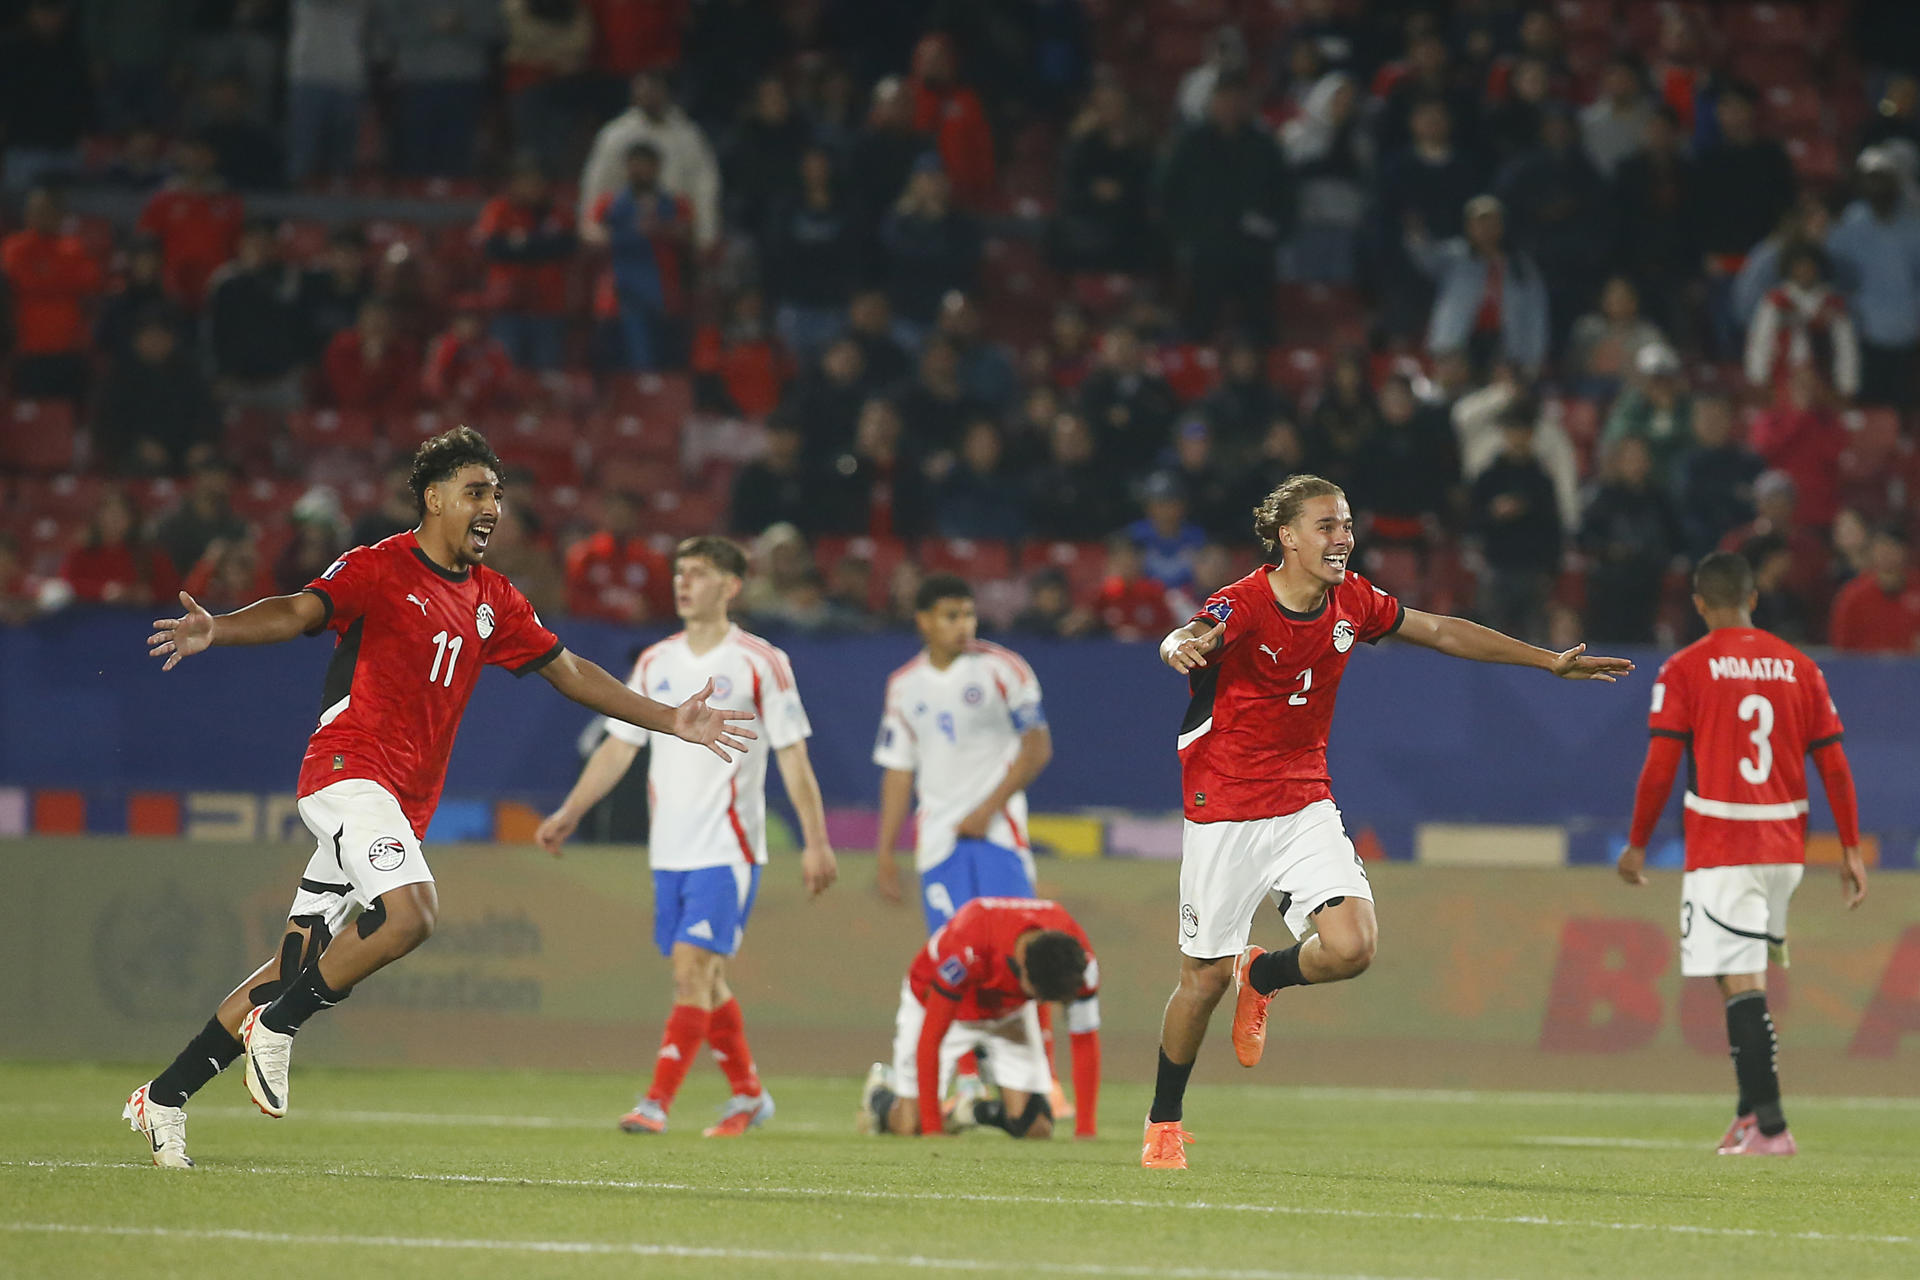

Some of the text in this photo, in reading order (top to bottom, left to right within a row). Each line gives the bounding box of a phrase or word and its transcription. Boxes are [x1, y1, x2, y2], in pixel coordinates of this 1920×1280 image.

[429, 630, 463, 688] 11
[1288, 667, 1312, 706] 2
[1738, 694, 1774, 785] 3
